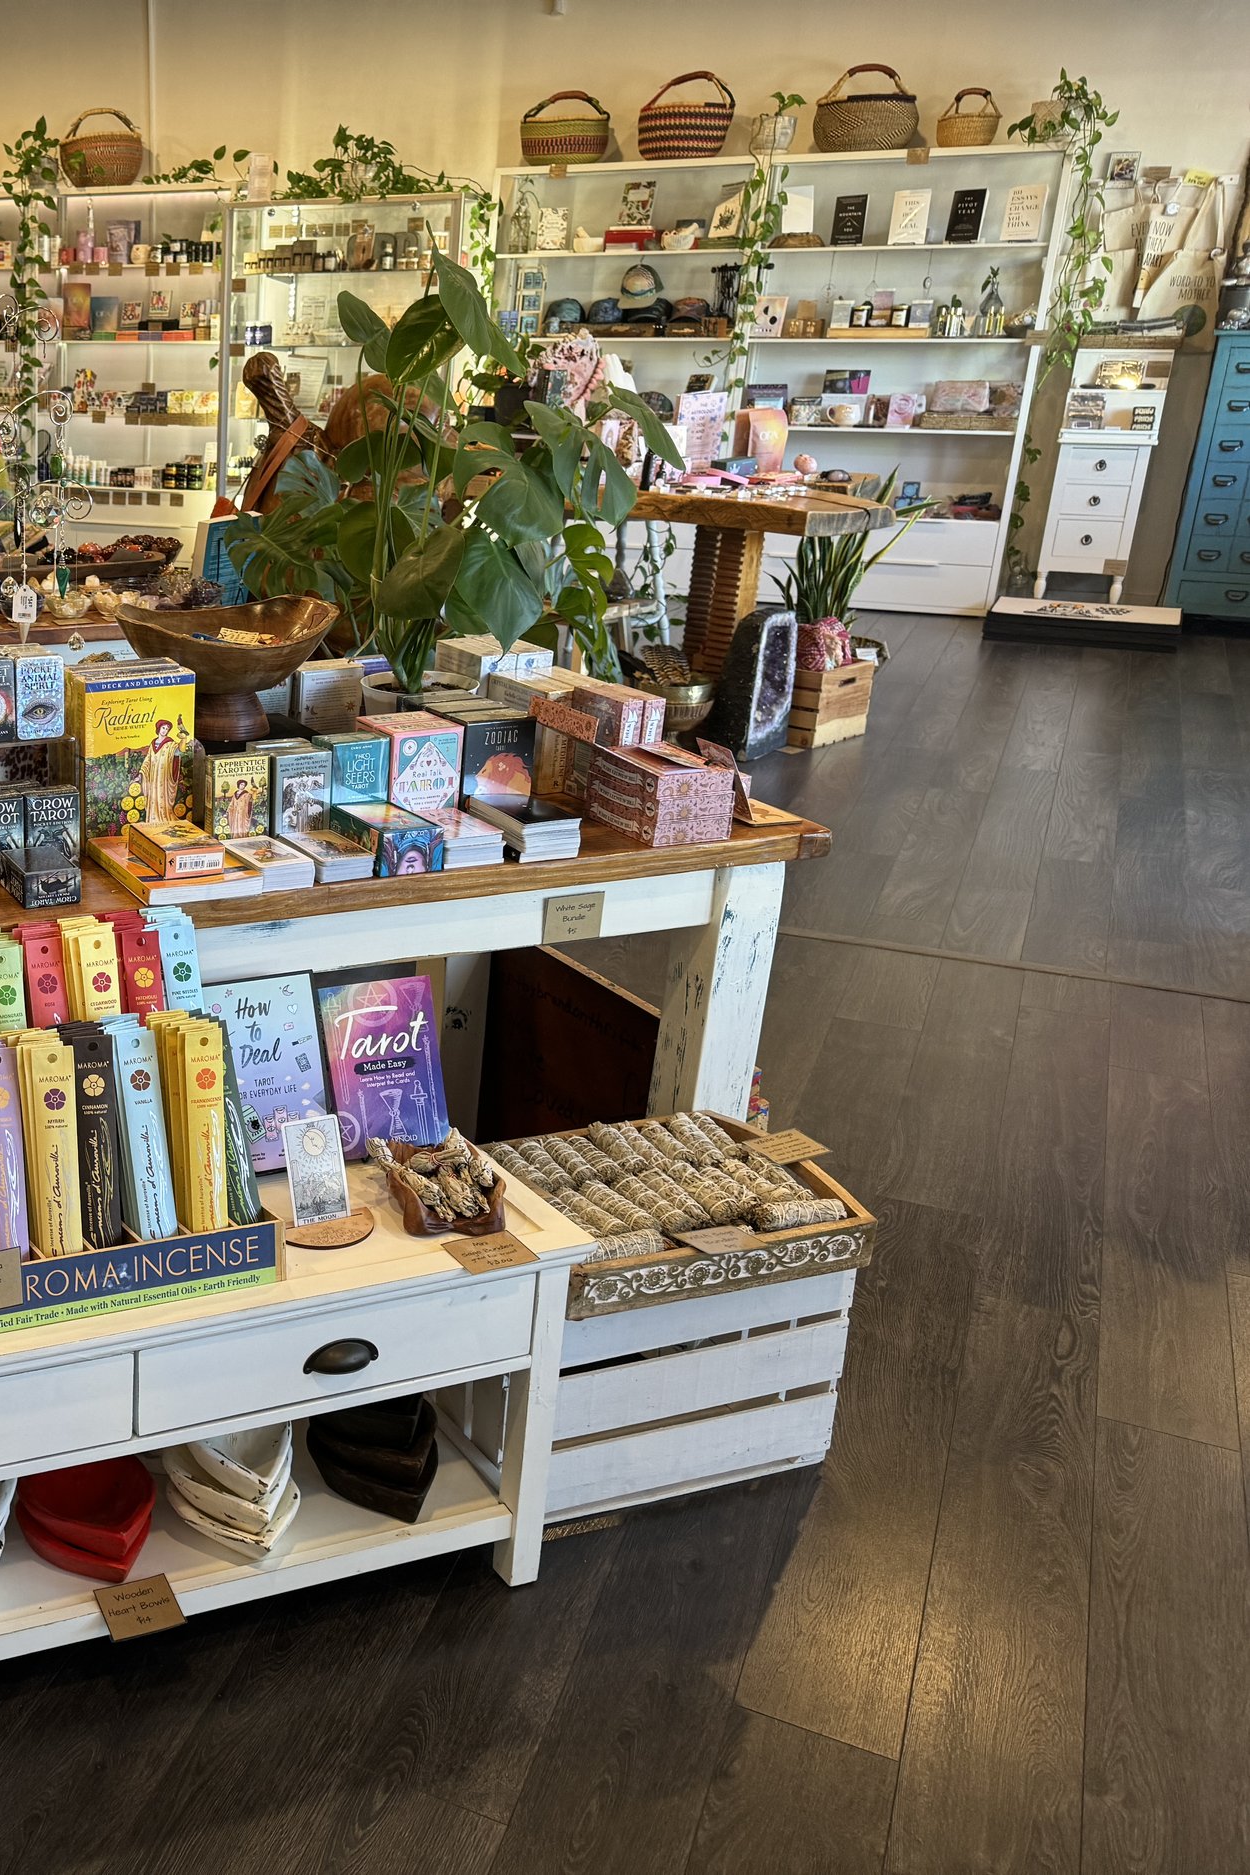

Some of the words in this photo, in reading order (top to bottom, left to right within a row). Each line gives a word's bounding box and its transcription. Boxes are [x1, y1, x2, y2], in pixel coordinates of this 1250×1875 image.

[1154, 223, 1175, 237] NOW
[1148, 237, 1167, 252] THEN
[1169, 276, 1191, 287] WORD
[1193, 276, 1203, 286] TO
[1178, 289, 1210, 300] MOTHER
[21, 665, 58, 675] POCKET
[21, 674, 59, 683] ANIMAL
[25, 682, 55, 690] SPIRIT
[101, 682, 121, 690] DECK
[101, 698, 125, 707] Exploring
[93, 705, 157, 736] Radiant
[485, 729, 519, 746] ZODIAC
[217, 759, 266, 769] APPRENTICE
[347, 758, 375, 773] LIGHT
[217, 767, 244, 775] TAROT
[412, 771, 429, 779] Real
[430, 770, 443, 778] Talk
[345, 771, 376, 785] SEER'S
[396, 776, 458, 794] TAROT
[32, 797, 74, 811] CROW
[30, 808, 76, 822] TAROT
[30, 898, 55, 907] TAROT
[56, 896, 77, 904] CROW
[578, 903, 596, 912] Sage
[563, 914, 586, 922] Bundle
[86, 960, 113, 968] MAROMA
[235, 997, 272, 1021] How
[245, 1022, 262, 1041] to
[335, 1006, 429, 1060] Tarot
[240, 1038, 282, 1069] Deal
[123, 1056, 152, 1066] MAROMA
[190, 1055, 219, 1063] MAROMA
[77, 1061, 108, 1070] MAROMA
[363, 1061, 386, 1072] Made
[387, 1060, 407, 1071] Easy
[39, 1075, 70, 1083] MAROMA
[254, 1077, 275, 1086] TAROT
[366, 1081, 386, 1089] Interpret
[25, 1261, 124, 1303] ROMA
[132, 1235, 261, 1284] INCENSE
[16, 1314, 33, 1326] Fair
[34, 1309, 60, 1323] Trade
[66, 1305, 89, 1316] Made
[90, 1302, 109, 1312] with
[110, 1294, 143, 1309] Natural
[144, 1289, 179, 1304] Essential
[180, 1286, 197, 1296] Oils
[203, 1279, 225, 1293] Earth
[227, 1273, 261, 1288] Friendly
[113, 1587, 154, 1602] Wooden
[108, 1605, 136, 1617] Heart
[140, 1597, 170, 1610] Bowls
[136, 1616, 153, 1625] $14
